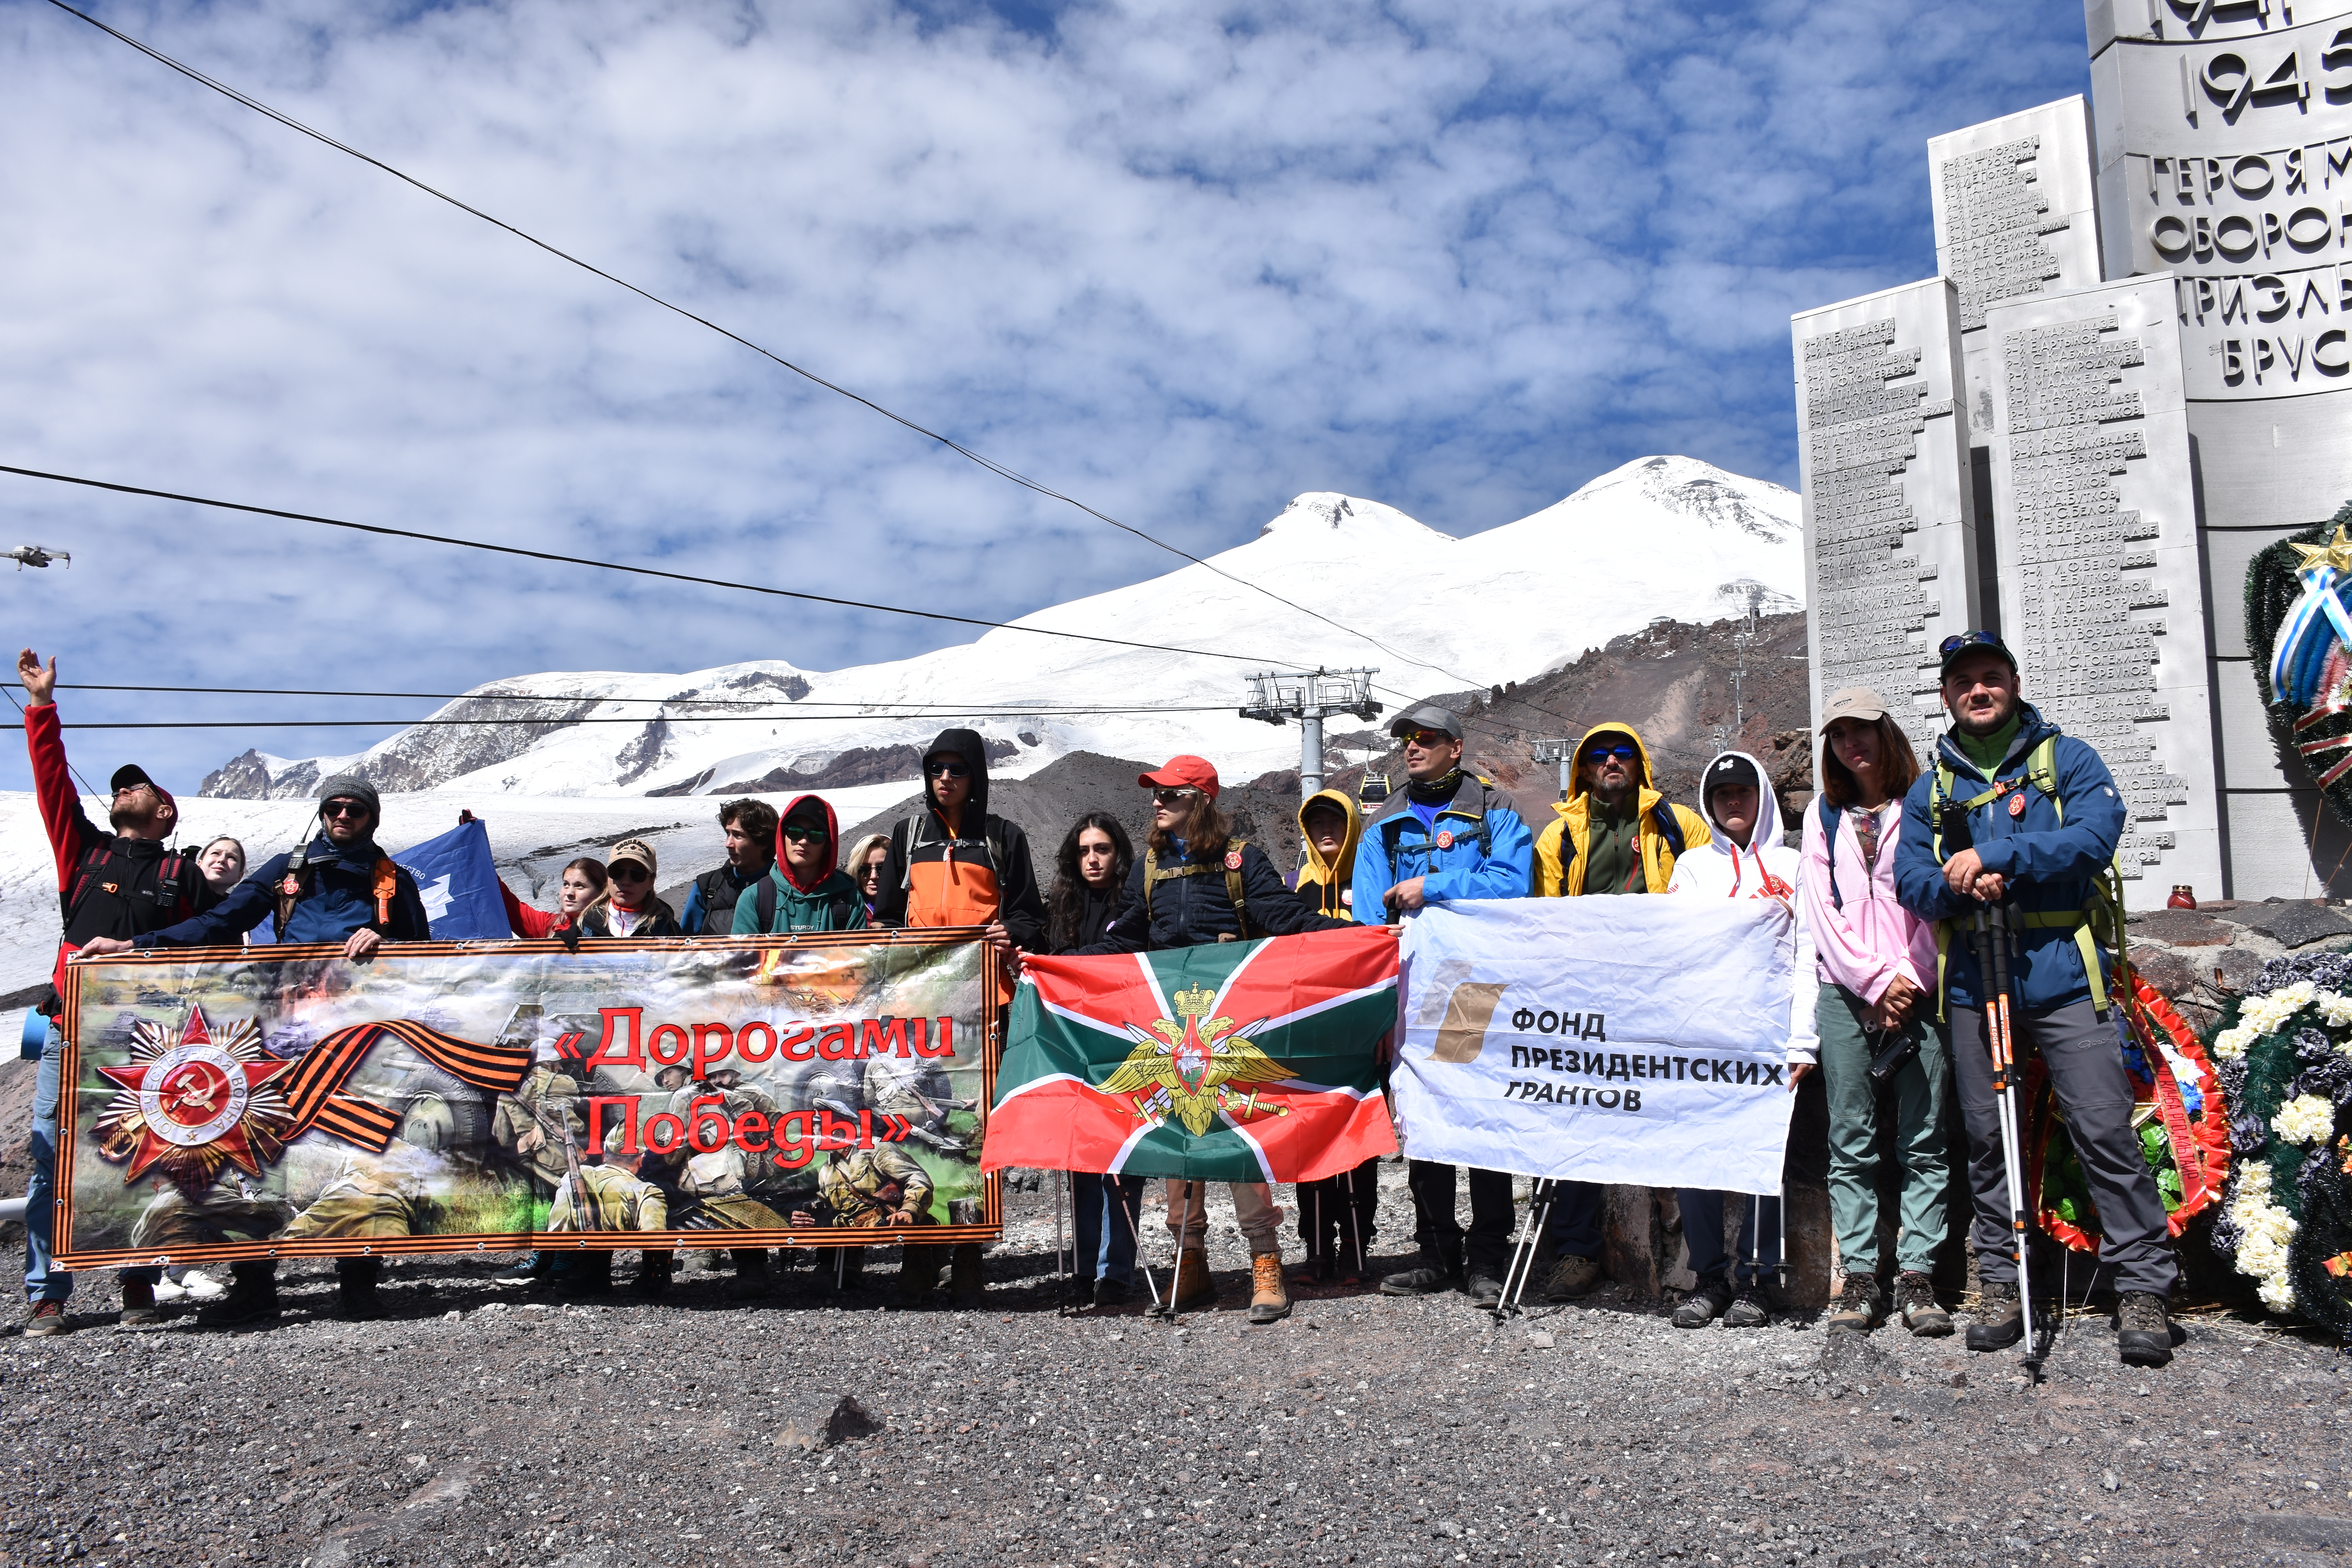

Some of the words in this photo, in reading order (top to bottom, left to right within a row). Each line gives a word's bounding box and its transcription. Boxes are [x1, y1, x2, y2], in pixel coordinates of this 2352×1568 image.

[554, 1007, 955, 1081] «Дорогами
[1512, 1007, 1606, 1042] ФОНД
[144, 1049, 236, 1134] ОТЕЧЕСТВЕННАЯ
[213, 1076, 246, 1130] ВОЙНА
[1511, 1045, 1784, 1086] ПРЕЗИДЕНТСКИХ
[1503, 1082, 1642, 1112] ГРАНТОВ
[586, 1093, 913, 1169] Победы»
